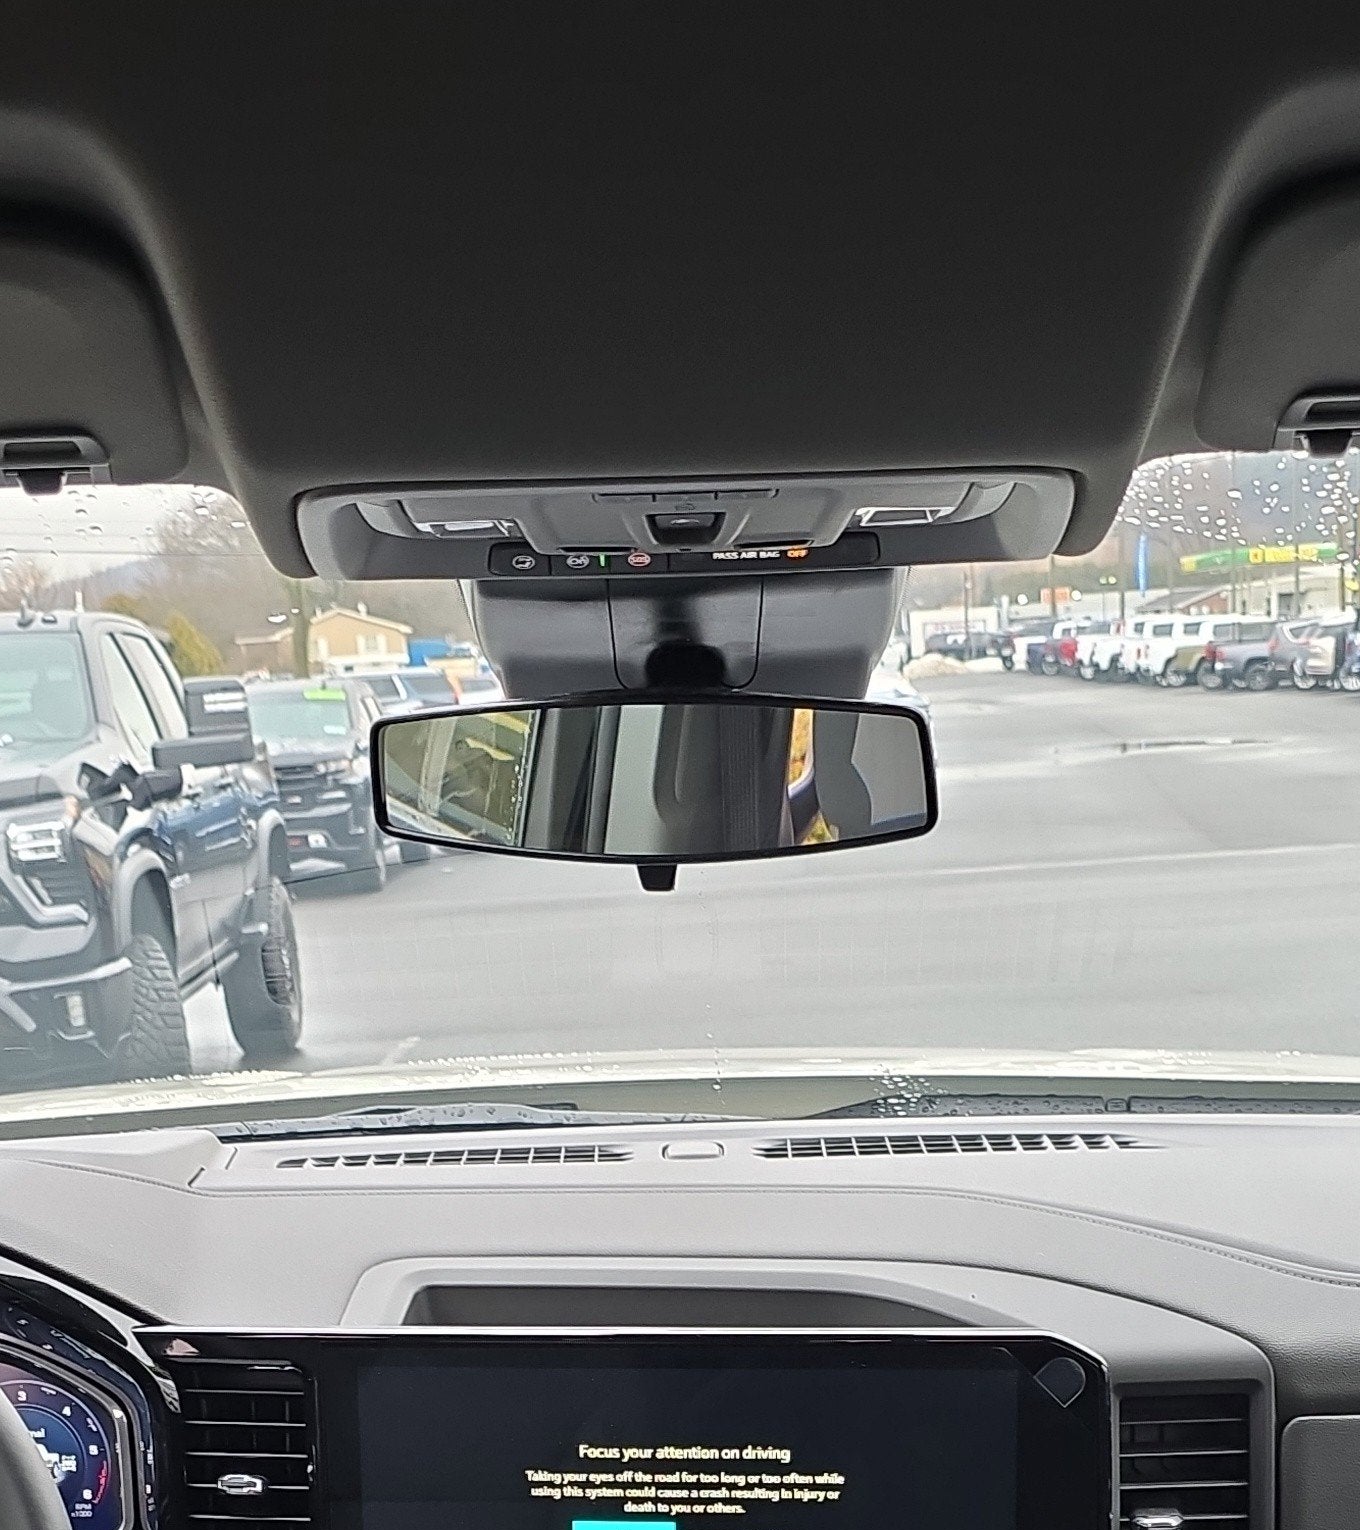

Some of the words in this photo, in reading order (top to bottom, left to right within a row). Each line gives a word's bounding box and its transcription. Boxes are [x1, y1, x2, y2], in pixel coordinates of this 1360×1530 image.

[712, 551, 739, 560] PASS
[740, 551, 758, 559] AIR
[759, 550, 781, 558] BAG
[62, 1406, 72, 1417] 4
[578, 1444, 621, 1459] Focus
[621, 1447, 654, 1462] your
[655, 1445, 720, 1460] attention
[721, 1448, 740, 1460] on
[742, 1445, 791, 1463] driving
[525, 1470, 562, 1485] Taking
[563, 1473, 588, 1485] your
[589, 1473, 615, 1485] eyes
[615, 1470, 633, 1482] off
[634, 1471, 653, 1482] the
[654, 1471, 680, 1483] road
[681, 1471, 698, 1483] for
[699, 1472, 720, 1483] too
[720, 1471, 746, 1486] long
[747, 1475, 761, 1484] or
[761, 1474, 781, 1484] too
[782, 1472, 813, 1484] often
[814, 1473, 846, 1484] while
[531, 1486, 562, 1500] using
[562, 1486, 584, 1497] this
[585, 1487, 624, 1500] system
[625, 1486, 656, 1498] could
[657, 1488, 689, 1498] cause
[690, 1489, 698, 1498] a
[699, 1487, 730, 1498] crash
[731, 1487, 780, 1502] resulting
[781, 1488, 791, 1499] in
[793, 1488, 826, 1502] injury
[826, 1490, 841, 1500] or
[623, 1501, 656, 1512] death
[657, 1502, 670, 1512] to
[670, 1504, 691, 1516] you
[692, 1504, 706, 1513] or
[706, 1502, 747, 1514] others.
